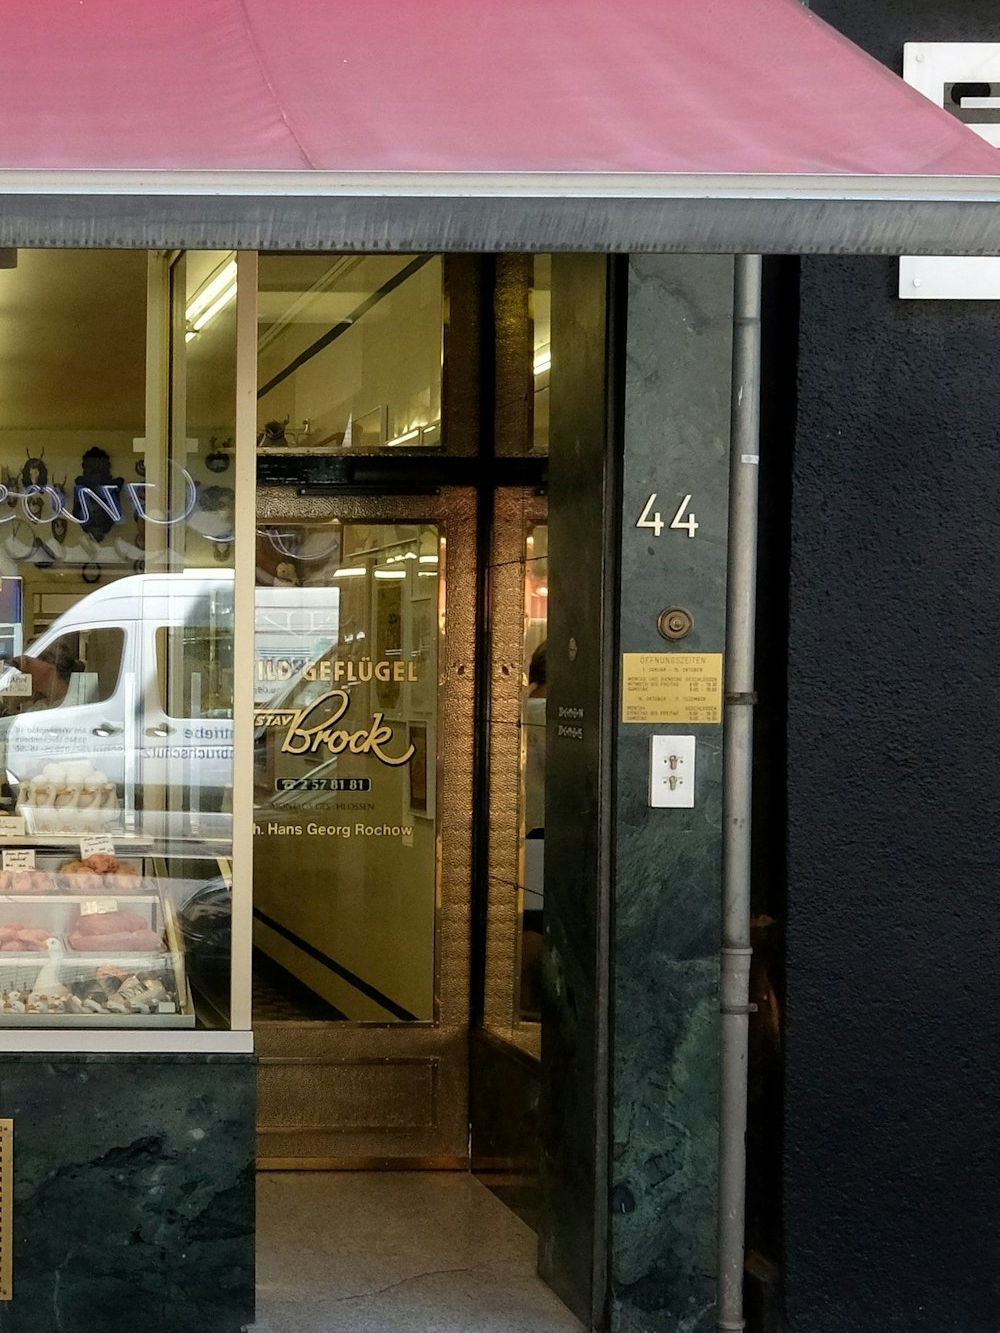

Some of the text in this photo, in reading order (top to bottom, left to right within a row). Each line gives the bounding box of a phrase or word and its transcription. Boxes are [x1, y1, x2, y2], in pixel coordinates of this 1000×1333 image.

[636, 493, 700, 538] 44
[254, 689, 416, 766] STAV Brock
[299, 779, 364, 790] 2 57 81 81
[268, 823, 303, 836] Hans
[306, 823, 351, 838] Georg
[354, 823, 414, 836] Rochow
